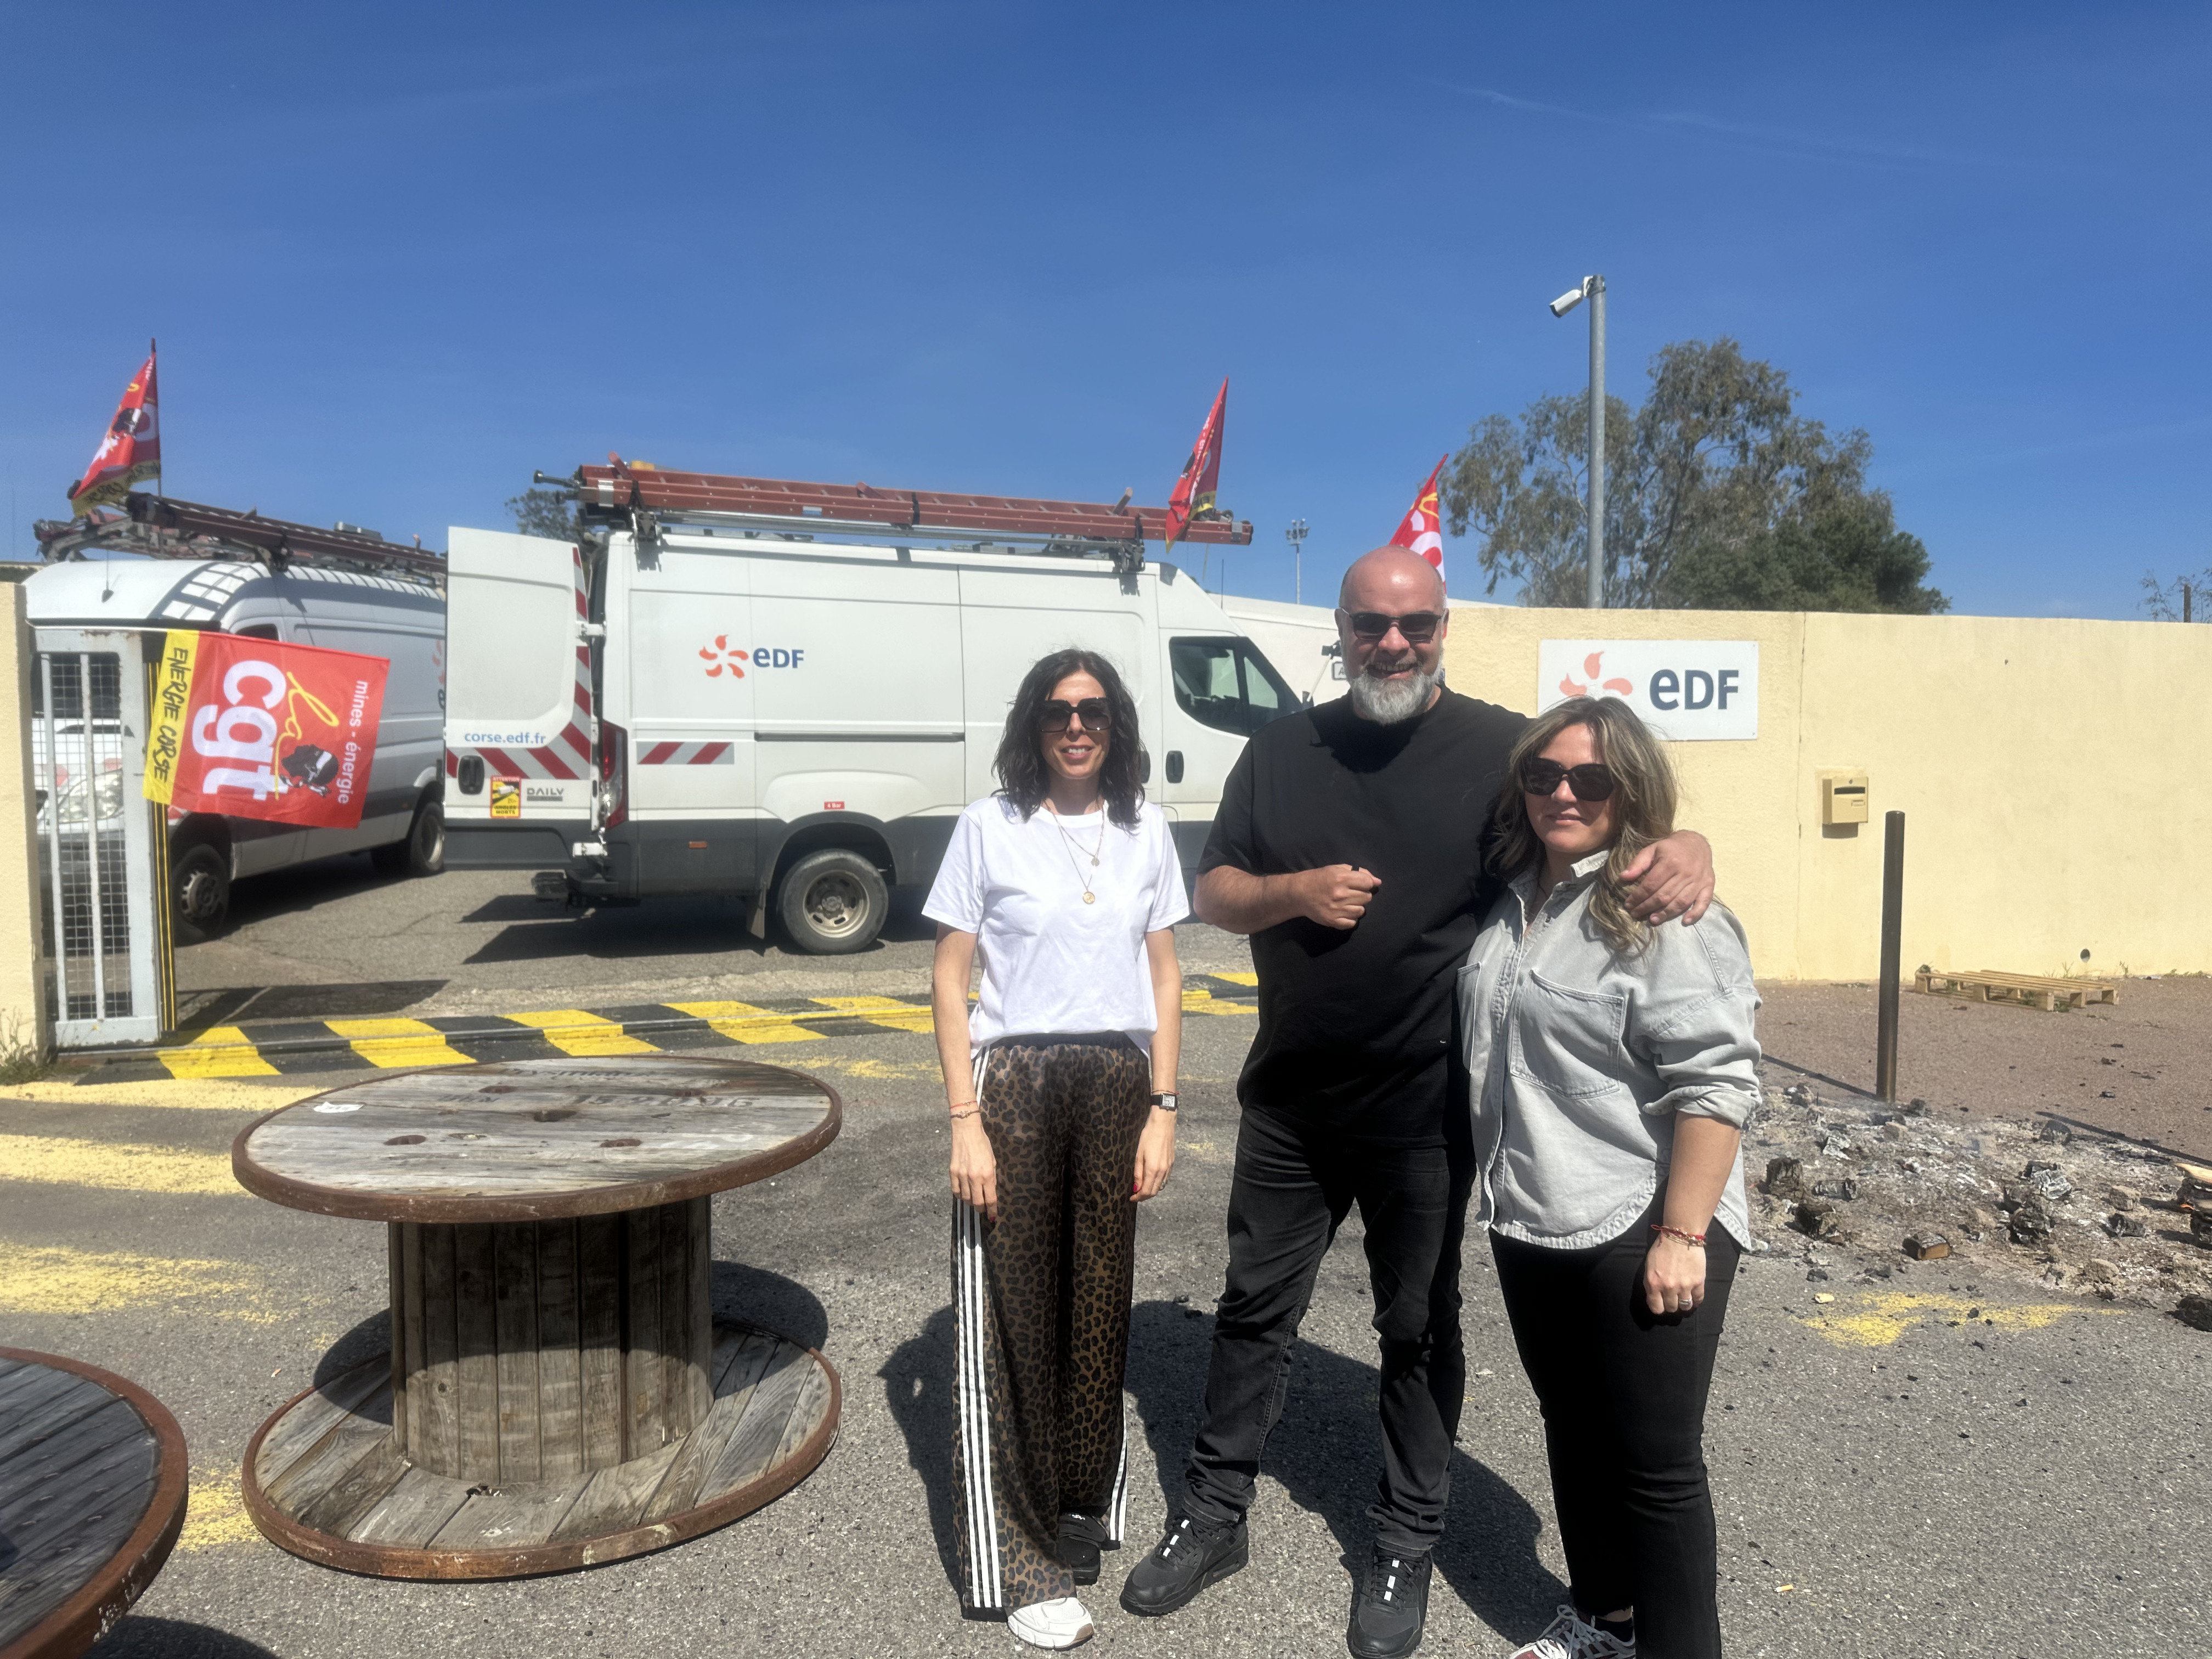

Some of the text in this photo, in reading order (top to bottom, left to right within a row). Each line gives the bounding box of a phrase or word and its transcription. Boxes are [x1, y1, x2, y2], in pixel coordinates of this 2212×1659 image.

[152, 647, 192, 783] ENERGIE CORSE
[191, 660, 289, 801] cgt
[349, 680, 368, 727] mines
[464, 732, 546, 744] corse.edf.fr
[336, 742, 358, 804] énergie
